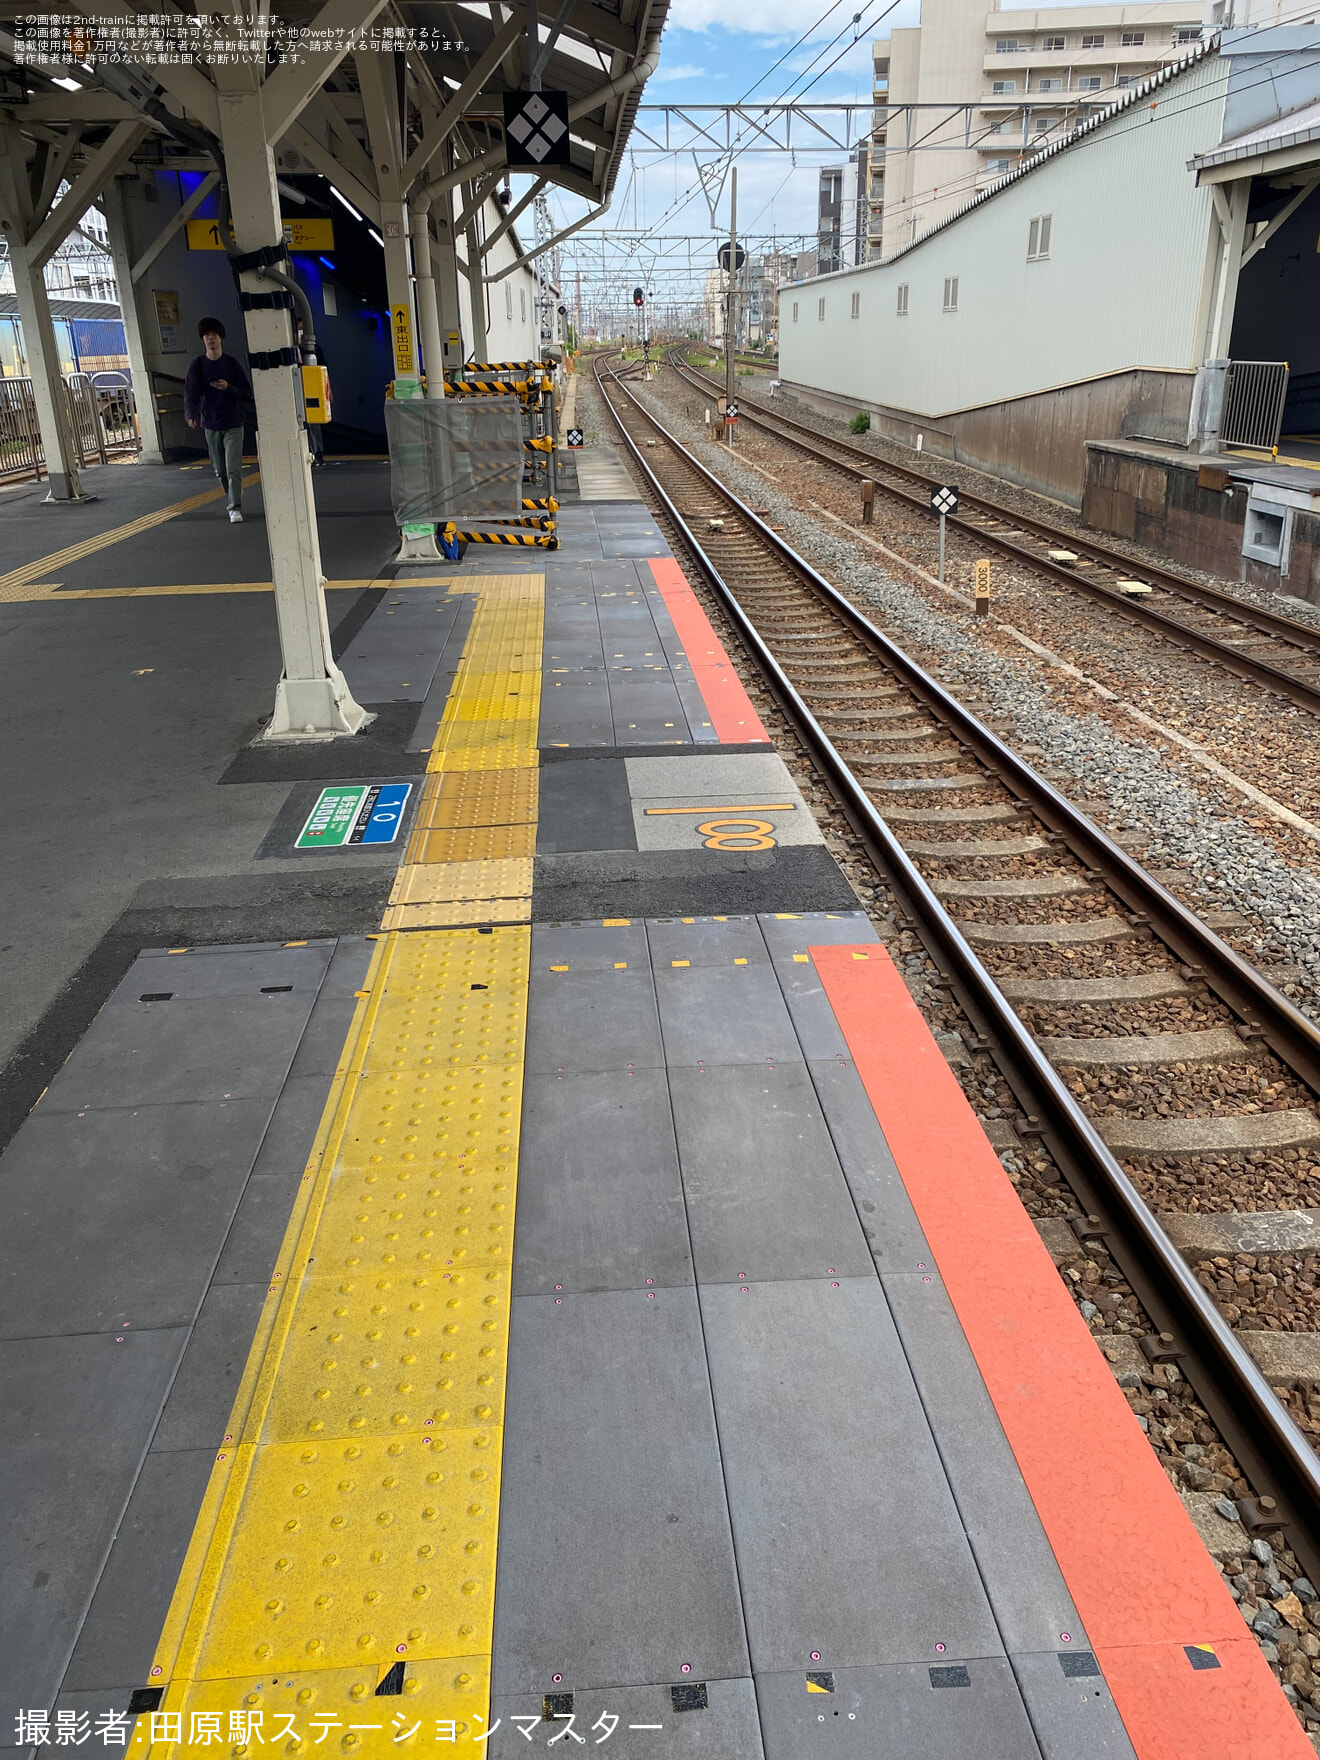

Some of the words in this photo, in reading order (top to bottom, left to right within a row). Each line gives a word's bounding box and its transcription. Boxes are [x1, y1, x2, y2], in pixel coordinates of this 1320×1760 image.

[395, 325, 409, 352] 東出口
[978, 567, 988, 592] 3000
[376, 800, 401, 822] 10
[696, 817, 777, 851] 8
